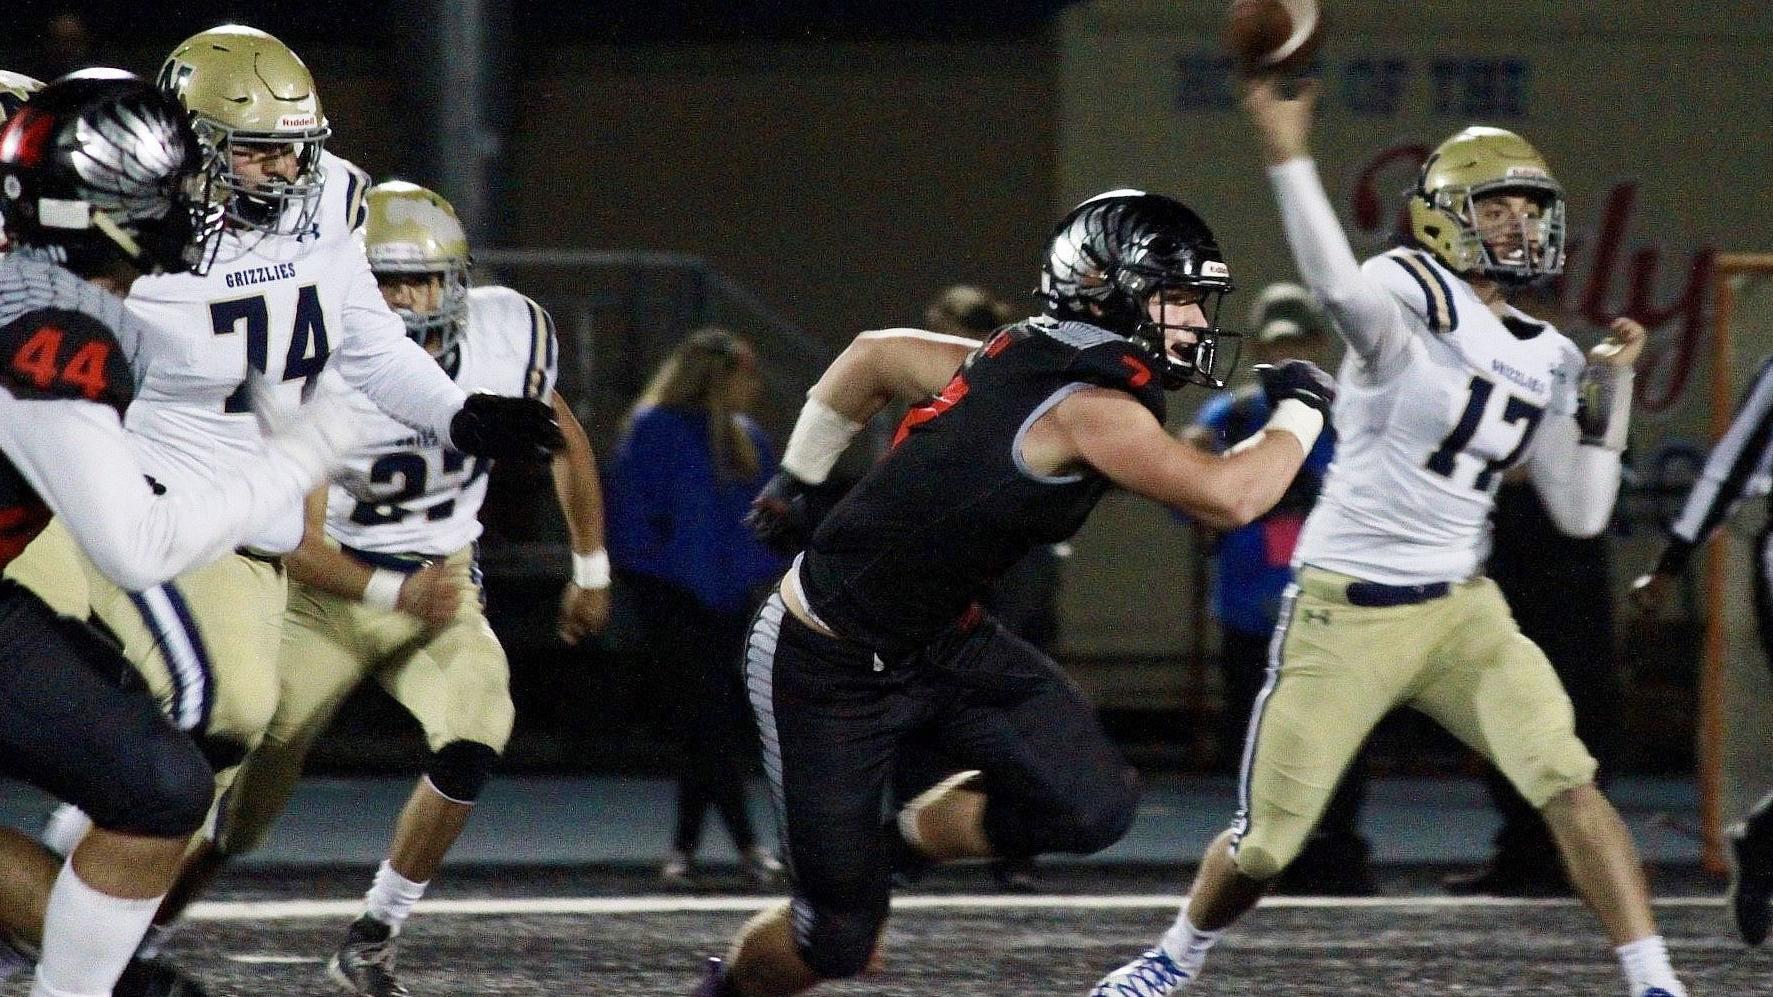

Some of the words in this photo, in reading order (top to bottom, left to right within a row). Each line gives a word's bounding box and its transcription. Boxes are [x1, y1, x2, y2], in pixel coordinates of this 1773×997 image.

[225, 262, 297, 289] GRIZZLIES
[12, 326, 109, 400] 44
[208, 283, 331, 414] 74
[1425, 374, 1547, 492] 17
